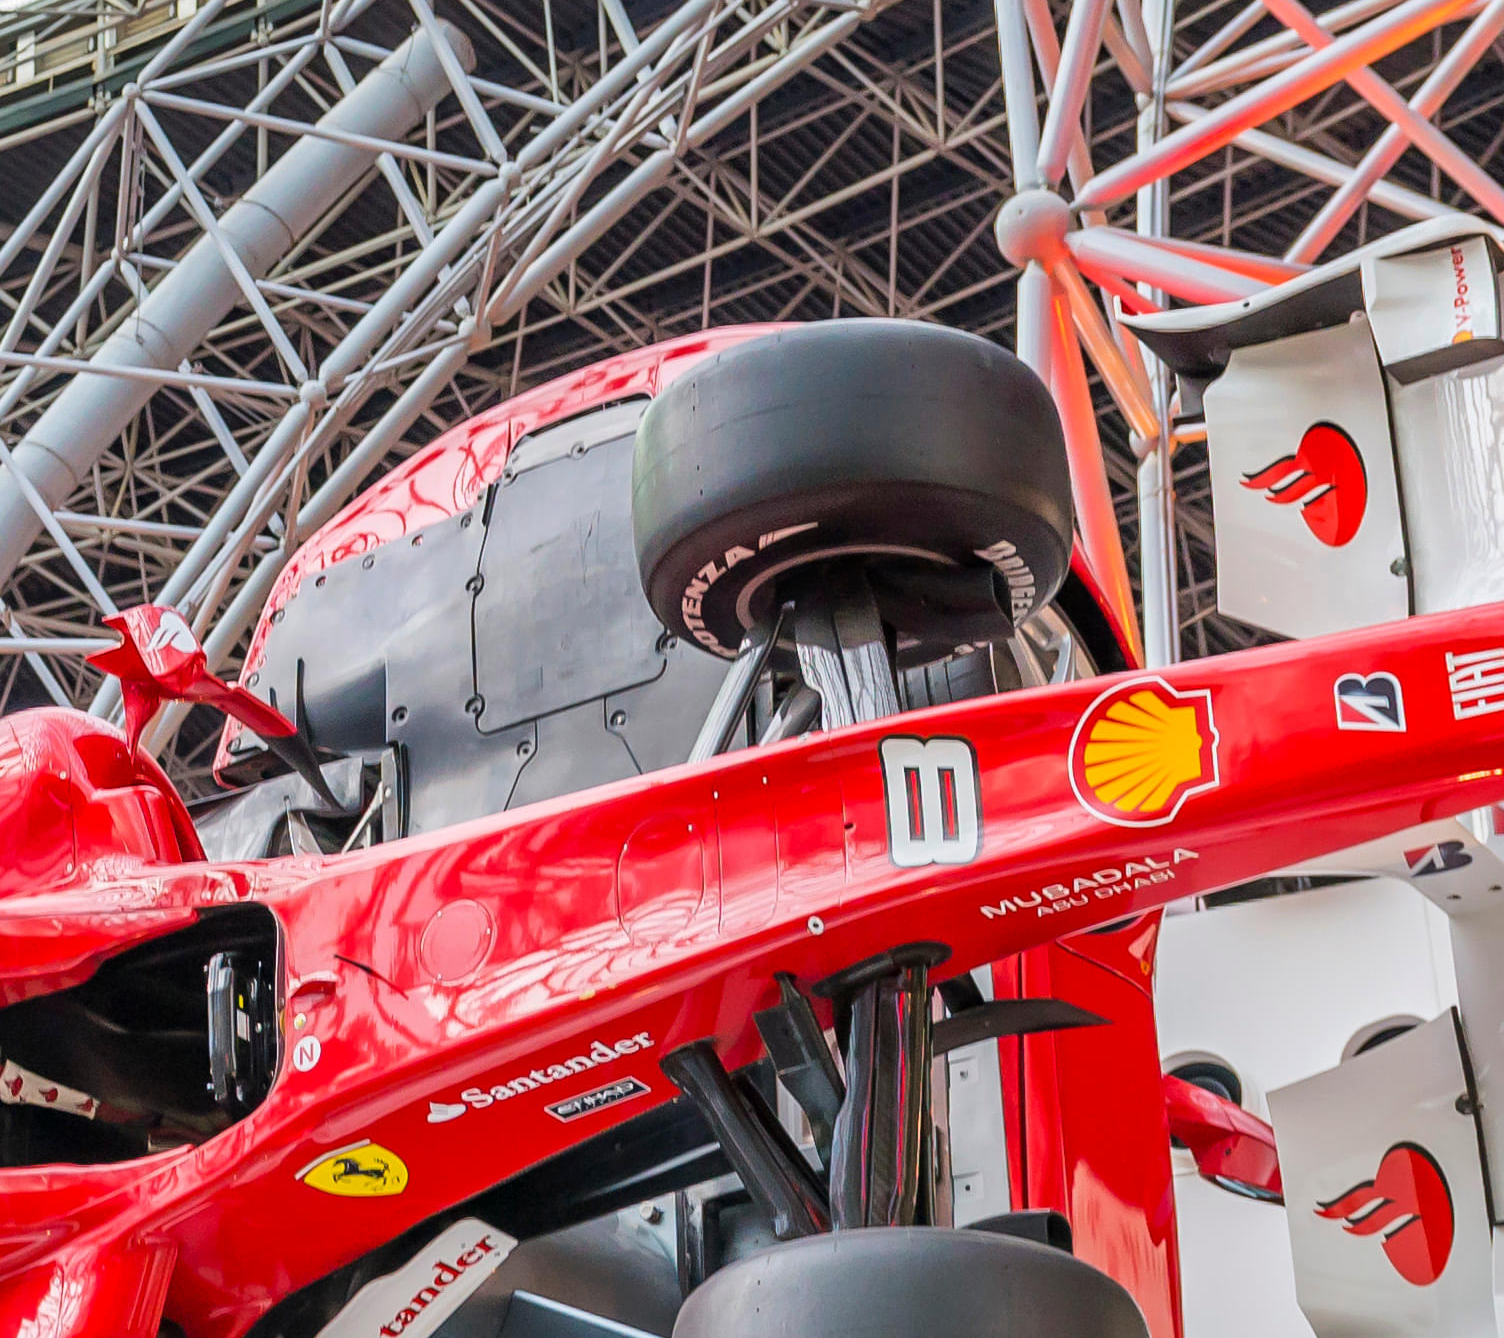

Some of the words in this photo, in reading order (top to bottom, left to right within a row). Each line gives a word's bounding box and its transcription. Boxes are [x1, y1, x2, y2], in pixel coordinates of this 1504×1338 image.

[1449, 246, 1471, 328] V-Power
[980, 847, 1200, 919] MUBADALA
[1037, 893, 1089, 917] ABU
[1094, 868, 1176, 900] DHABI
[461, 1031, 655, 1109] Santander
